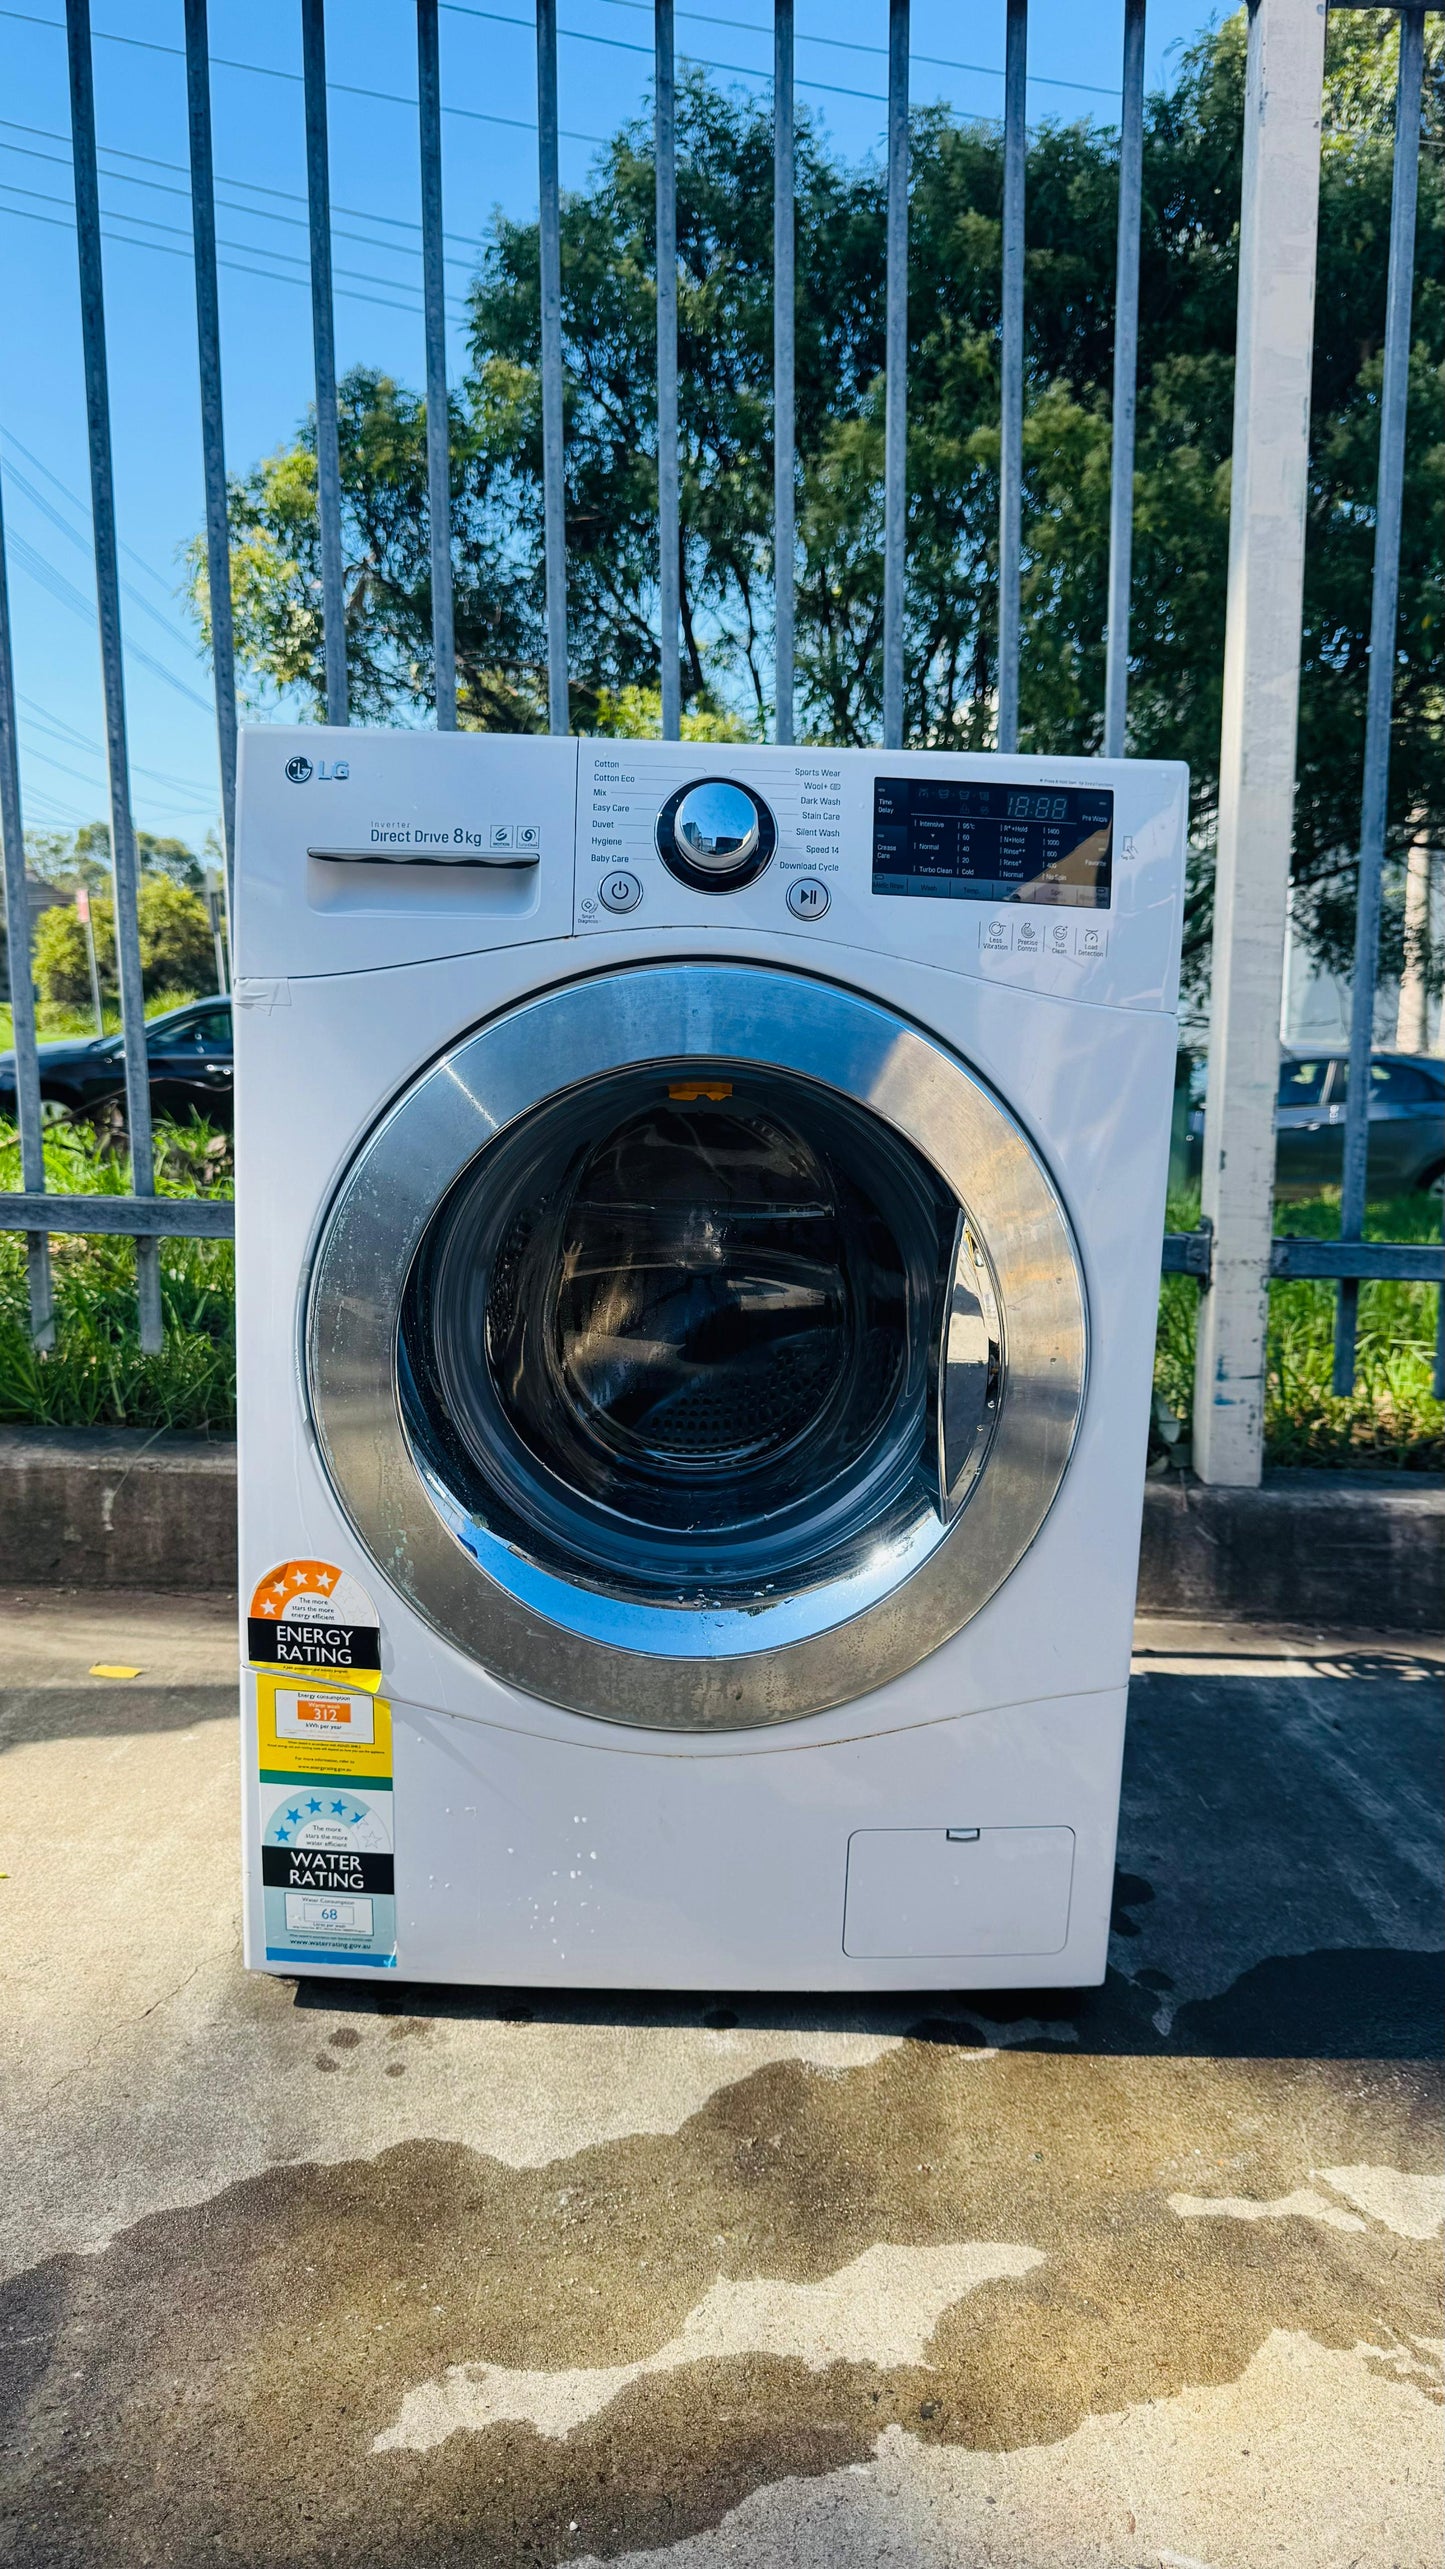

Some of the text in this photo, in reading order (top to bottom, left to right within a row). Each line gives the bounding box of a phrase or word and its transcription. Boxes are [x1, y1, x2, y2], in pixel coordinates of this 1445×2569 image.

[594, 760, 619, 768] Cotton
[318, 760, 349, 780] LG
[794, 768, 840, 777] Sports Wear
[594, 773, 635, 783] Cotton Eco
[800, 796, 841, 806] Dark Wash
[593, 803, 630, 812] Easy Care
[878, 806, 894, 814] Delay
[802, 811, 840, 821] Stain Care
[592, 820, 614, 828] Duvet
[919, 820, 945, 828] Intensive
[371, 829, 411, 842] Direct
[415, 830, 449, 844] Drive
[796, 828, 840, 837] Silent Wash
[591, 837, 622, 847] Hygiene
[919, 843, 939, 851] Normal
[806, 845, 839, 854] Speed 14
[591, 854, 629, 863] Baby Care
[779, 861, 839, 872] Download Cycle
[312, 1613, 335, 1621] efficient
[276, 1626, 354, 1646] ENERGY
[277, 1644, 352, 1664] RATING
[298, 1692, 315, 1700] Energy
[313, 1709, 337, 1721] 312
[290, 1851, 362, 1871] WATER
[289, 1869, 364, 1889] RATING
[321, 1908, 338, 1920] 68
[289, 1939, 371, 1950] www.waterrating.gov.au
